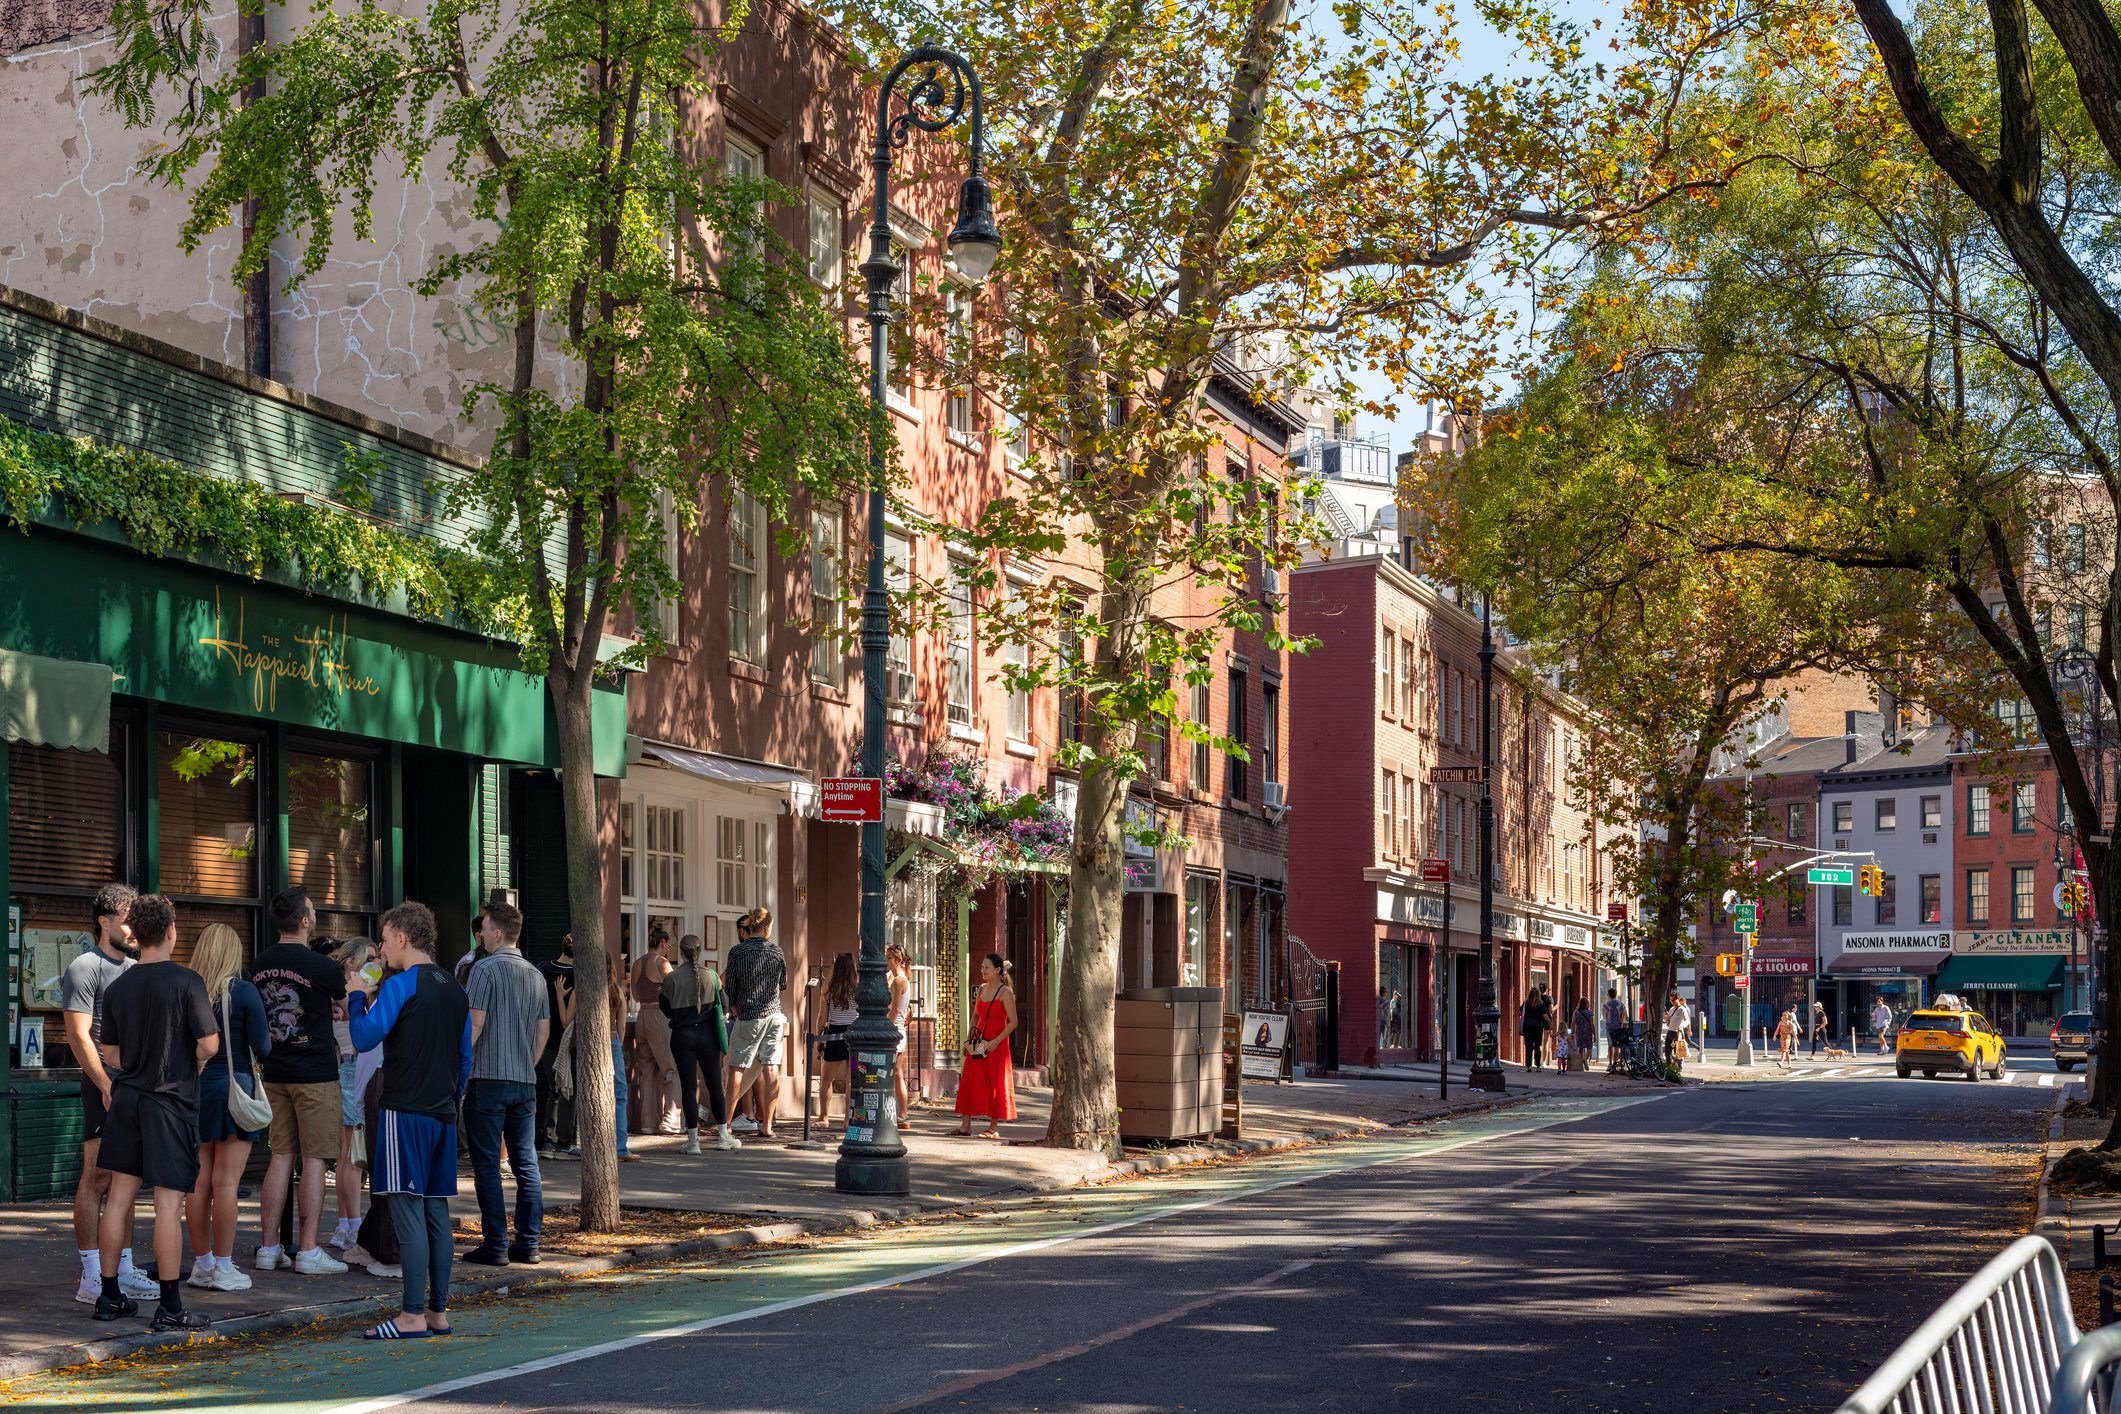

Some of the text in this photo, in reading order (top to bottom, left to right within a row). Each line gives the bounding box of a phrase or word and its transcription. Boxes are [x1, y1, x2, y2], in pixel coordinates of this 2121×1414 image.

[262, 635, 280, 648] THE
[199, 584, 380, 713] Happiest Hour
[1432, 769, 1478, 782] PATCHIN PL
[823, 782, 871, 791] NO STOPPING
[824, 792, 854, 802] Anytime
[1845, 936, 1885, 949] ANSONIA
[1889, 935, 1939, 948] PHARMACY
[1996, 933, 2071, 945] CLEANERS
[1755, 963, 1763, 972] &
[1766, 963, 1809, 973] LIQUOR
[252, 968, 312, 988] TOKYO MINDS
[1986, 982, 2018, 990] CLEANERS
[25, 1027, 40, 1054] A
